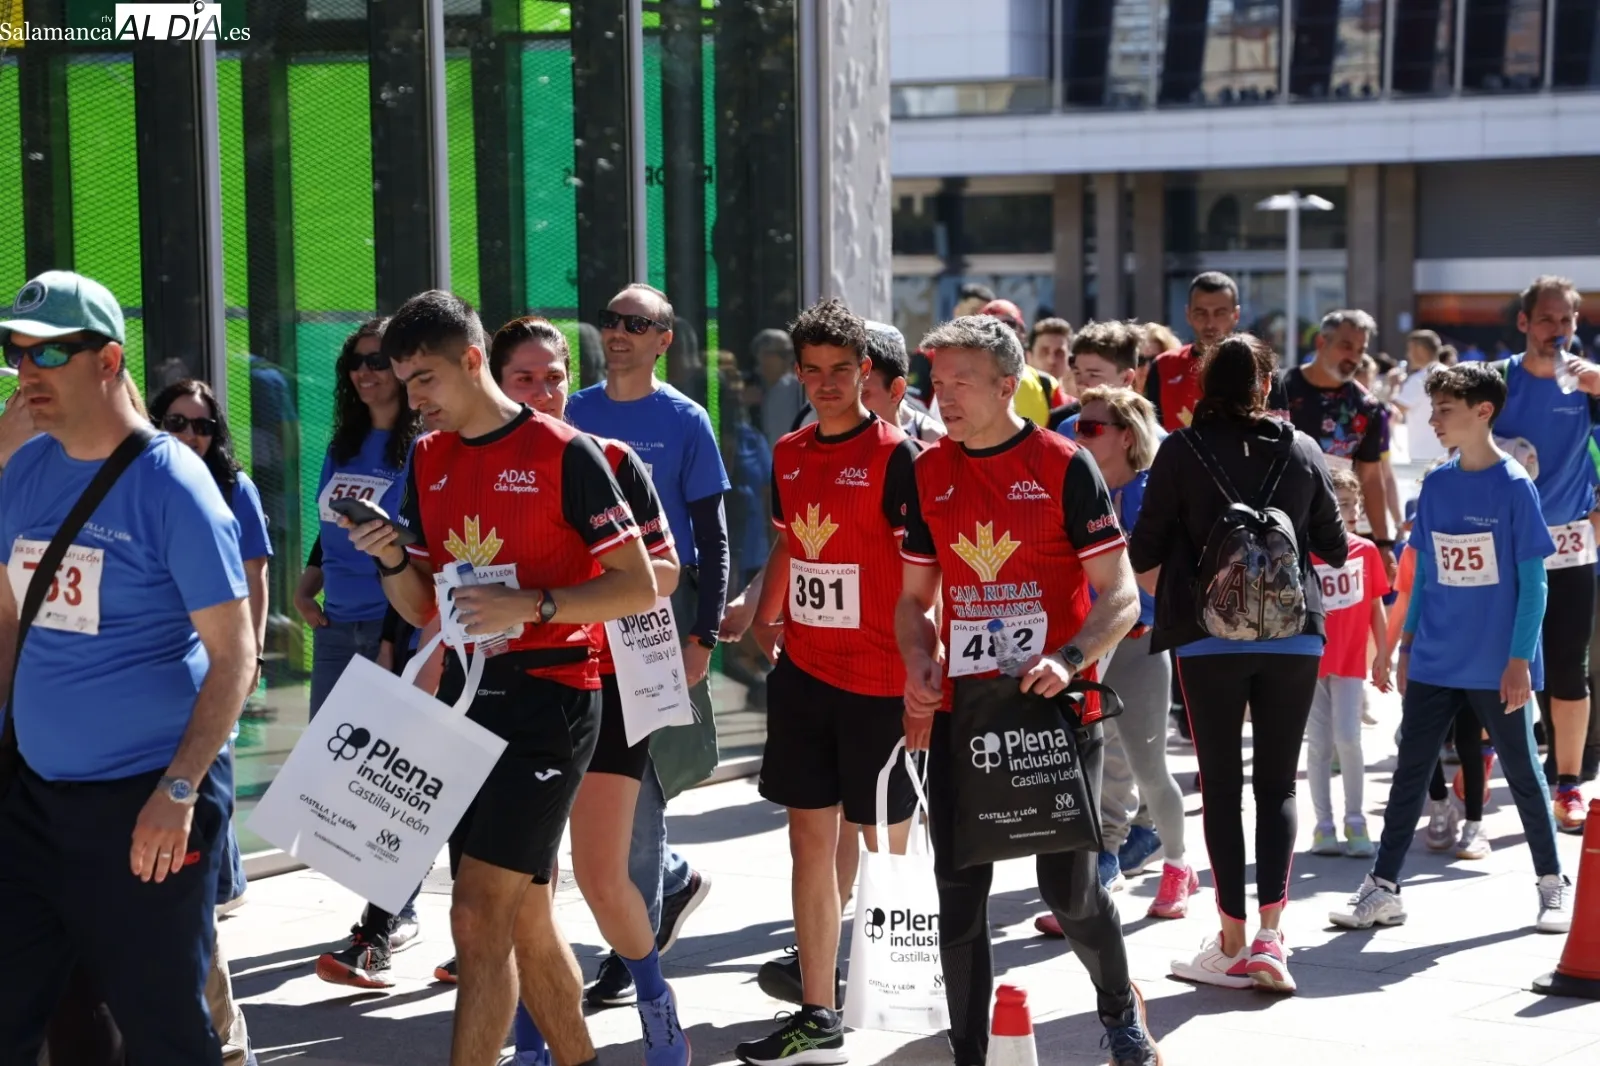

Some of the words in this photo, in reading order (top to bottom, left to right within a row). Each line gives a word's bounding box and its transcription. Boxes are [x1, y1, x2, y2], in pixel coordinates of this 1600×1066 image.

[498, 469, 536, 484] ADAS
[840, 467, 868, 479] ADAS
[494, 483, 508, 492] Club
[509, 484, 539, 494] Deportivo
[1007, 492, 1022, 501] Club
[1023, 492, 1051, 501] Deportiv
[1557, 532, 1584, 555] 23
[1441, 545, 1484, 571] 525
[496, 569, 514, 578] LEÓN
[804, 567, 830, 575] CASTILLA
[795, 574, 844, 610] 391
[983, 581, 1042, 601] RURAL
[1322, 569, 1360, 598] 601
[628, 607, 671, 635] Plena
[954, 623, 968, 631] DÍA
[1023, 617, 1045, 626] LEÓN
[1004, 728, 1068, 755] Plena
[366, 738, 443, 800] Plena
[1008, 749, 1071, 771] inclusión
[357, 760, 431, 815] inclusión
[1011, 772, 1050, 788] Castilla
[1050, 772, 1057, 785] y
[1058, 767, 1081, 781] León
[300, 793, 328, 815] CASTILLA
[331, 812, 337, 820] Y
[338, 816, 357, 831] LEÓN
[348, 780, 391, 812] Castilla
[390, 806, 400, 819] y
[400, 810, 430, 836] León
[978, 812, 1011, 820] CASTILLA
[1013, 810, 1018, 818] Y
[1020, 806, 1038, 816] LEÓN
[891, 908, 940, 931] Plen
[890, 932, 938, 947] inclusi
[890, 951, 930, 962] Castilla
[932, 953, 938, 964] y
